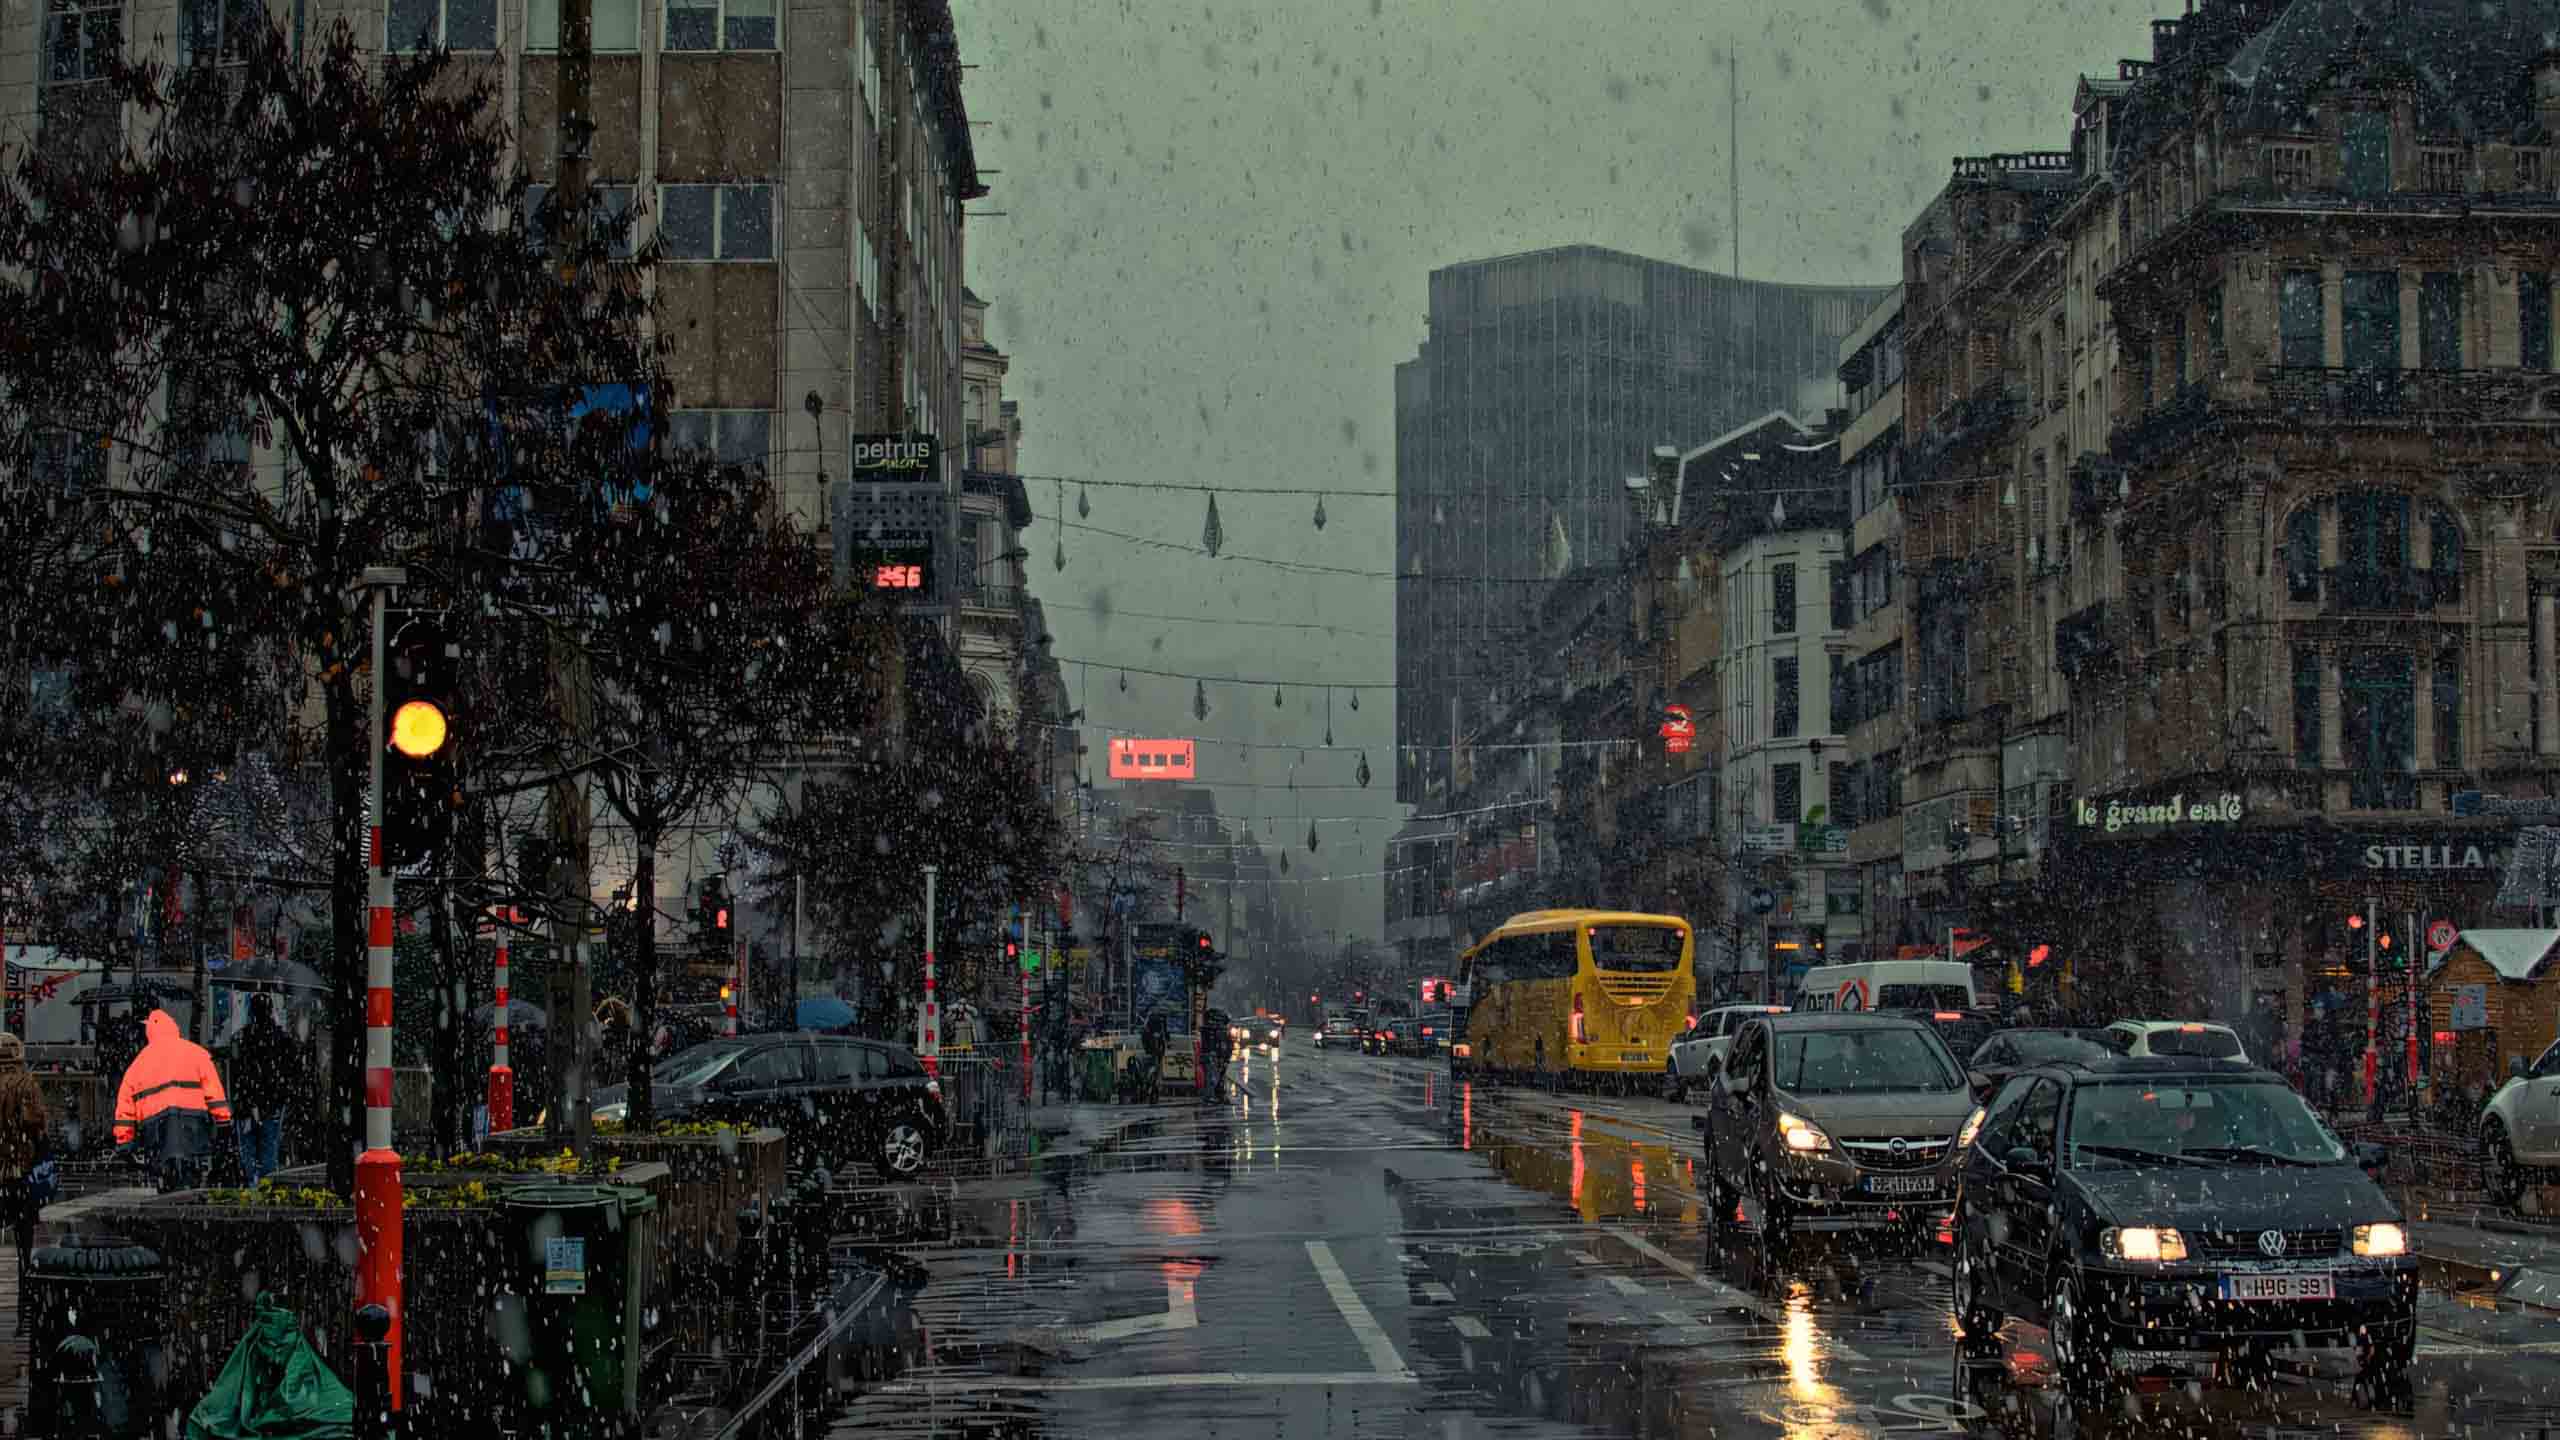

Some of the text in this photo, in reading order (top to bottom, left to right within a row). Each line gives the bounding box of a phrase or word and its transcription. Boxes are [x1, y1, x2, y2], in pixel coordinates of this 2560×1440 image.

[855, 438, 929, 465] petrus
[2077, 794, 2241, 832] le grand café
[2366, 845, 2485, 869] STELLA
